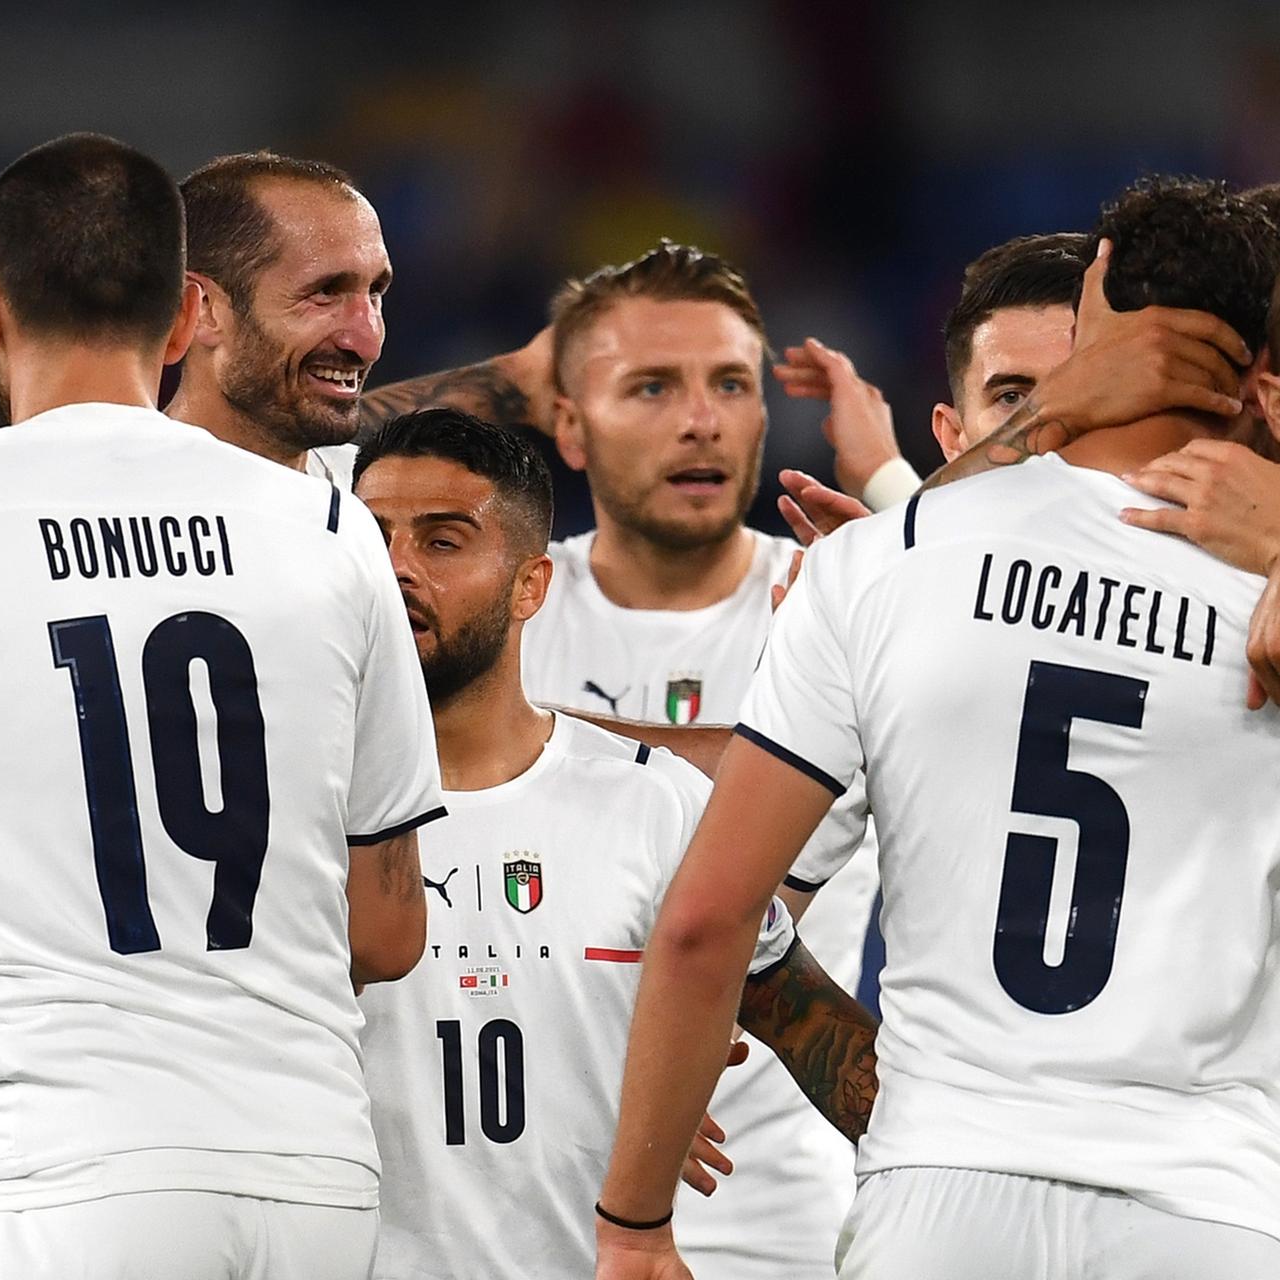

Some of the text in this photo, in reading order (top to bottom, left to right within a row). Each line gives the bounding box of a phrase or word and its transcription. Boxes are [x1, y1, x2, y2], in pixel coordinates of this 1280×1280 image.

[38, 515, 234, 581] BONUCCI
[973, 553, 1217, 666] LOCATELLI
[46, 610, 271, 956] 19
[992, 659, 1150, 1015] 5
[506, 864, 539, 873] ITALIA
[431, 944, 550, 959] TALIA
[436, 1018, 526, 1146] 10
